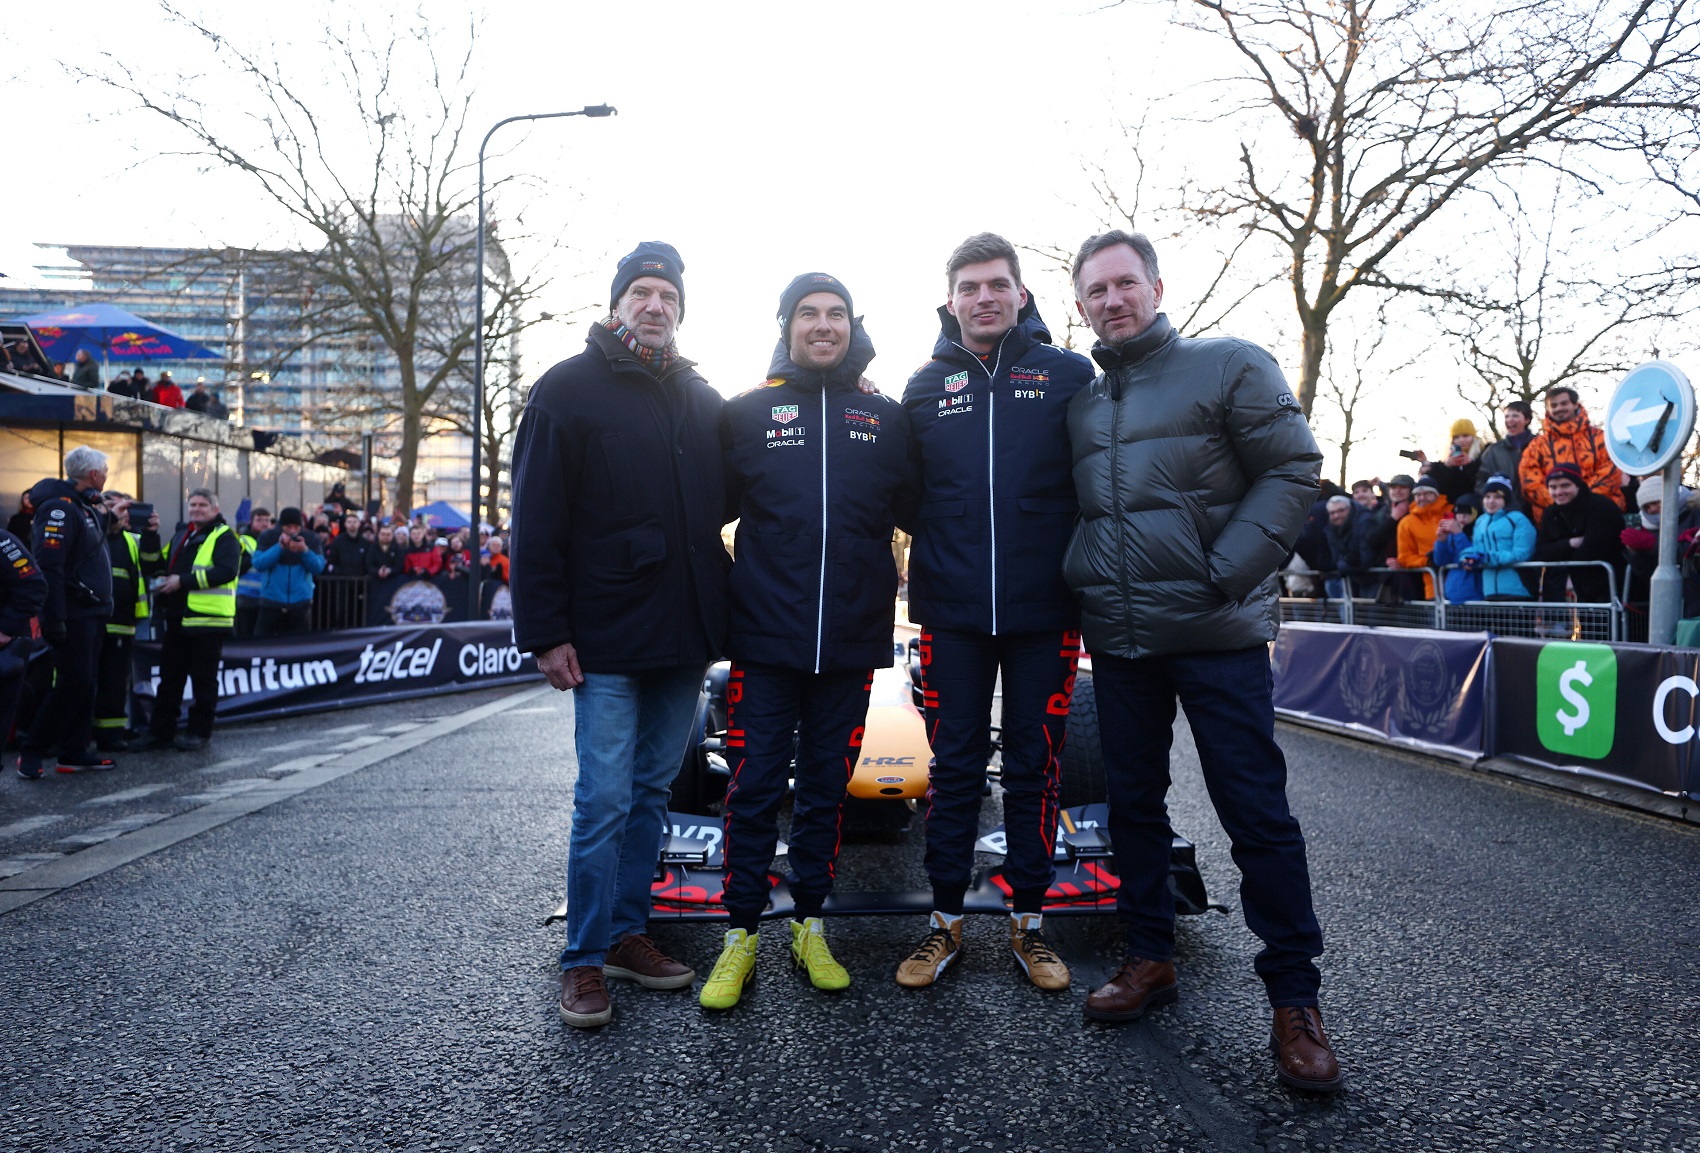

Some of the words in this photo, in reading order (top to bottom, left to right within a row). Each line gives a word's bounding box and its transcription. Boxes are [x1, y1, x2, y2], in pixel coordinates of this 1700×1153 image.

[1011, 366, 1049, 376] ORACLE
[948, 374, 966, 383] TAG
[946, 380, 968, 391] HEUER
[1014, 389, 1046, 400] BYBIT
[938, 395, 963, 409] Mobil
[773, 412, 798, 421] HEUER
[845, 407, 880, 420] ORACLE
[938, 405, 973, 418] ORACLE
[845, 420, 881, 430] RACING
[766, 427, 794, 439] Mobil
[850, 430, 877, 444] BYBIT
[766, 439, 805, 449] ORACLE
[151, 657, 338, 699] iinitum
[354, 638, 443, 684] telcel
[861, 756, 916, 766] HRC
